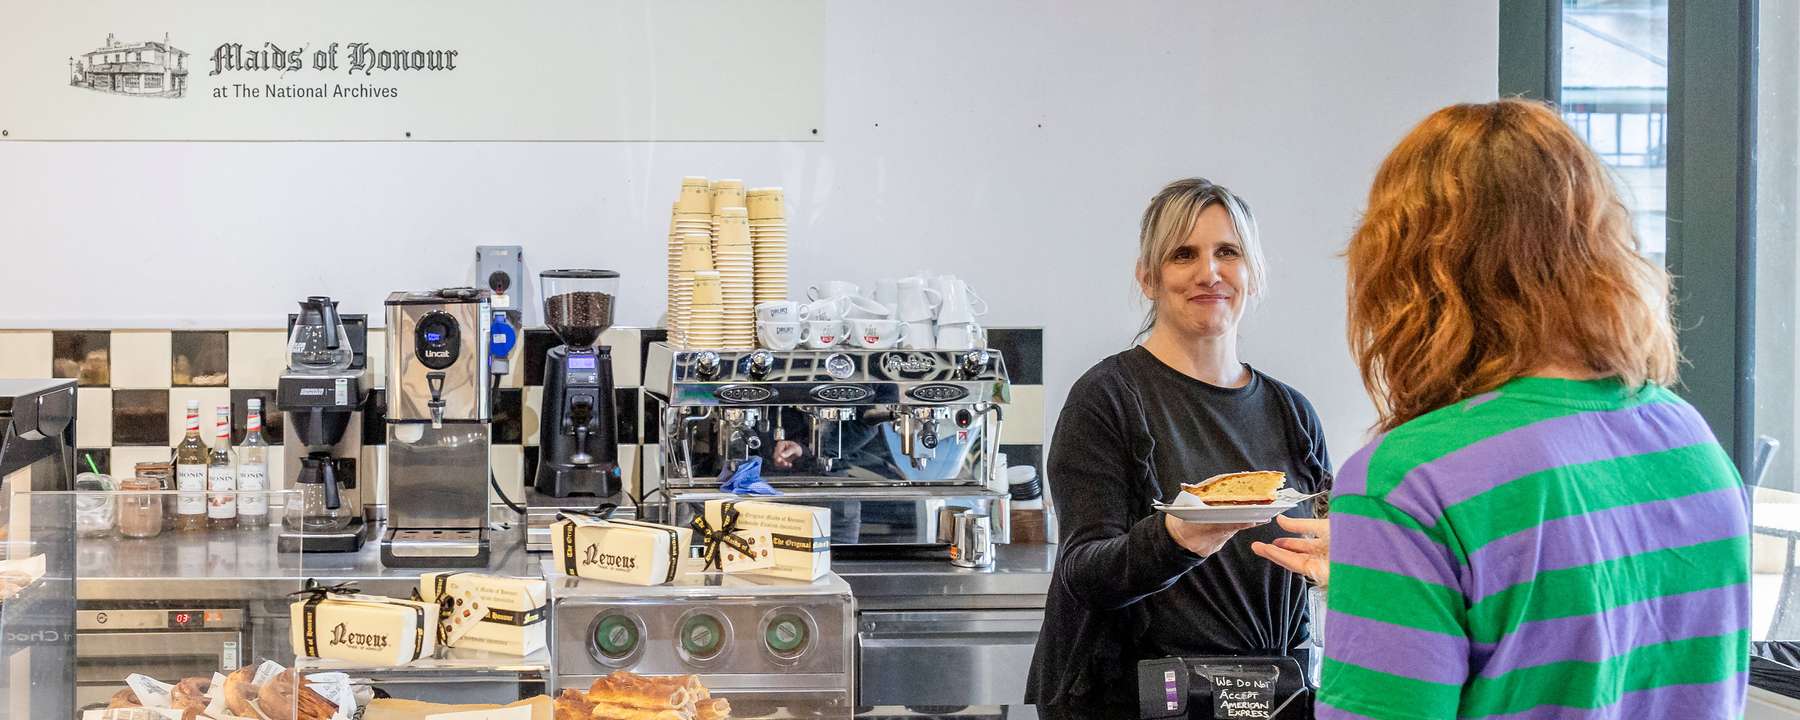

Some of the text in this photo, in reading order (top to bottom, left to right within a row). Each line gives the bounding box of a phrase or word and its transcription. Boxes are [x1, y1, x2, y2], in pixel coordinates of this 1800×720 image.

[209, 42, 459, 77] Maids of Honour
[212, 83, 399, 98] at The National Archives
[582, 543, 636, 569] Newens
[329, 622, 389, 648] Newens
[1220, 700, 1270, 709] AMERICAN
[1227, 709, 1270, 718] EXPRESS
